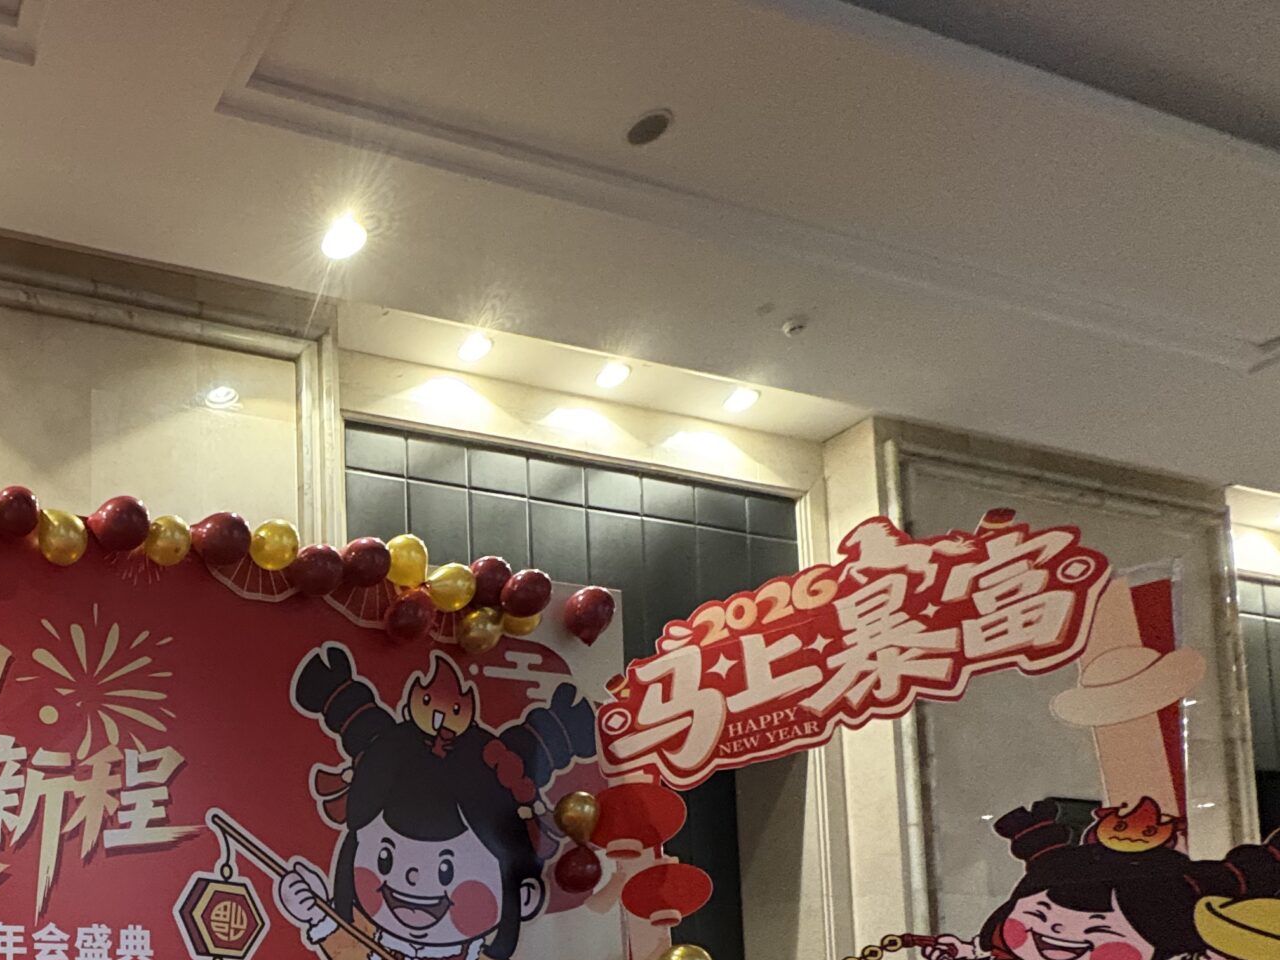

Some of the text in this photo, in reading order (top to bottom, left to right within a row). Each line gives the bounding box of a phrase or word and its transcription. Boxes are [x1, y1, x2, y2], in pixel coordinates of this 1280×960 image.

[692, 568, 839, 646] 2026
[608, 530, 1075, 769] 马上暴富
[719, 720, 820, 756] NEW YEAR
[727, 706, 798, 738] HAPPY
